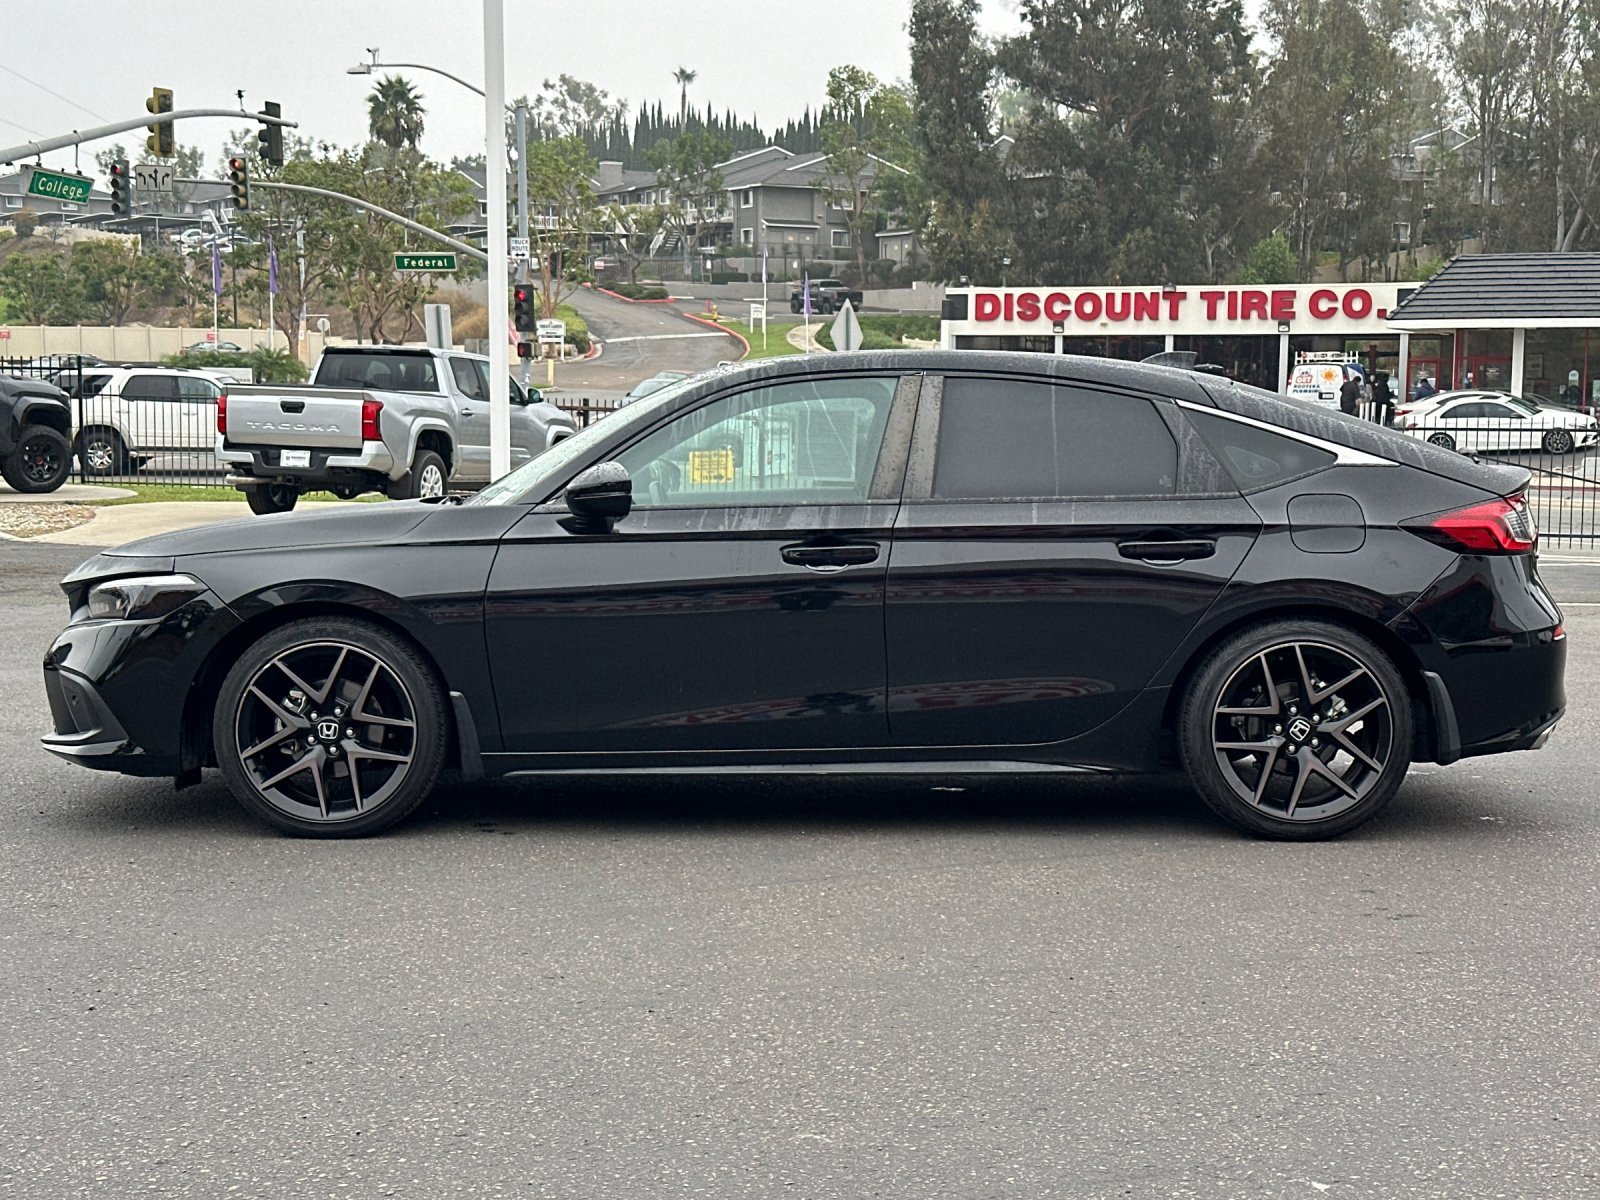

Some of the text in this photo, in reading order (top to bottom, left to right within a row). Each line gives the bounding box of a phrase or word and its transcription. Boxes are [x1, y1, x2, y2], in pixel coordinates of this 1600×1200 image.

[38, 177, 83, 200] College
[403, 258, 448, 267] Federal
[974, 288, 1388, 322] DISCOUNT TIRE CO.
[246, 421, 341, 433] TACOMA
